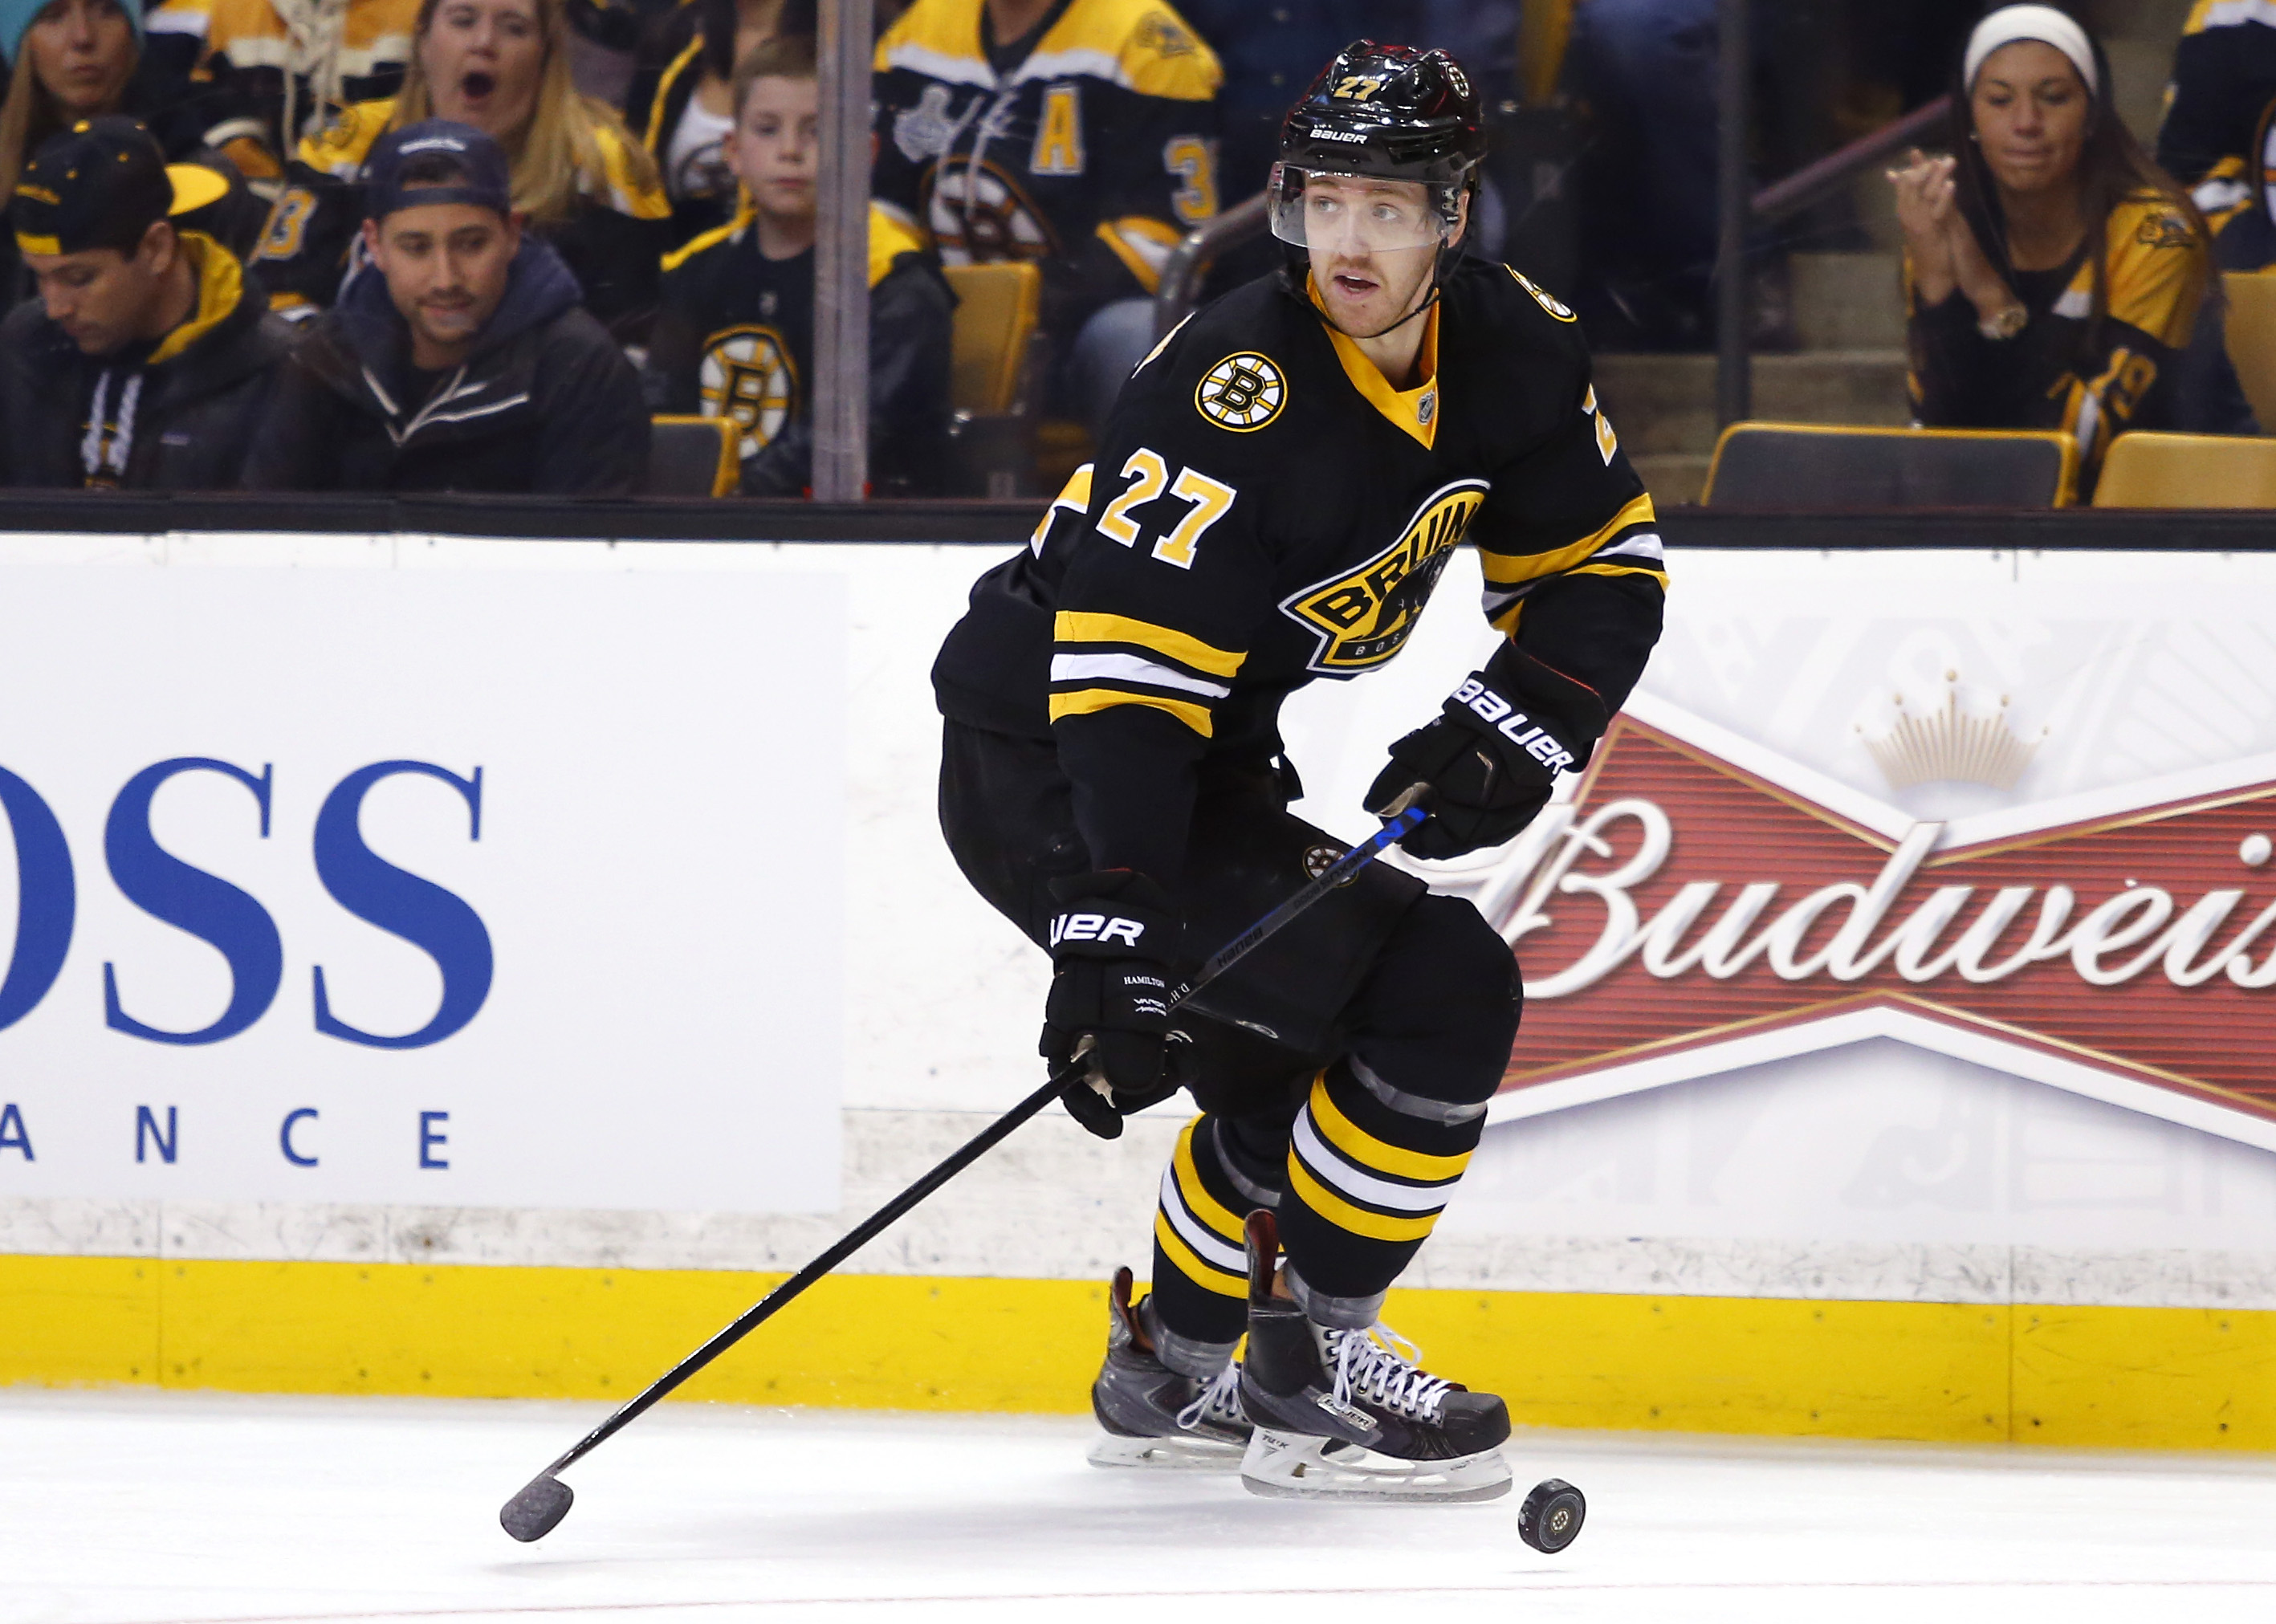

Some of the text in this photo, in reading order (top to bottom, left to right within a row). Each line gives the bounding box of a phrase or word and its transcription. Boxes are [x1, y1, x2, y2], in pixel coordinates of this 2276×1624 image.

[1333, 75, 1380, 101] 27
[1029, 86, 1085, 176] A
[1309, 128, 1368, 144] BAUER
[1095, 446, 1238, 571] 27
[1452, 678, 1575, 776] BAUER
[1123, 975, 1165, 989] HAMILTON
